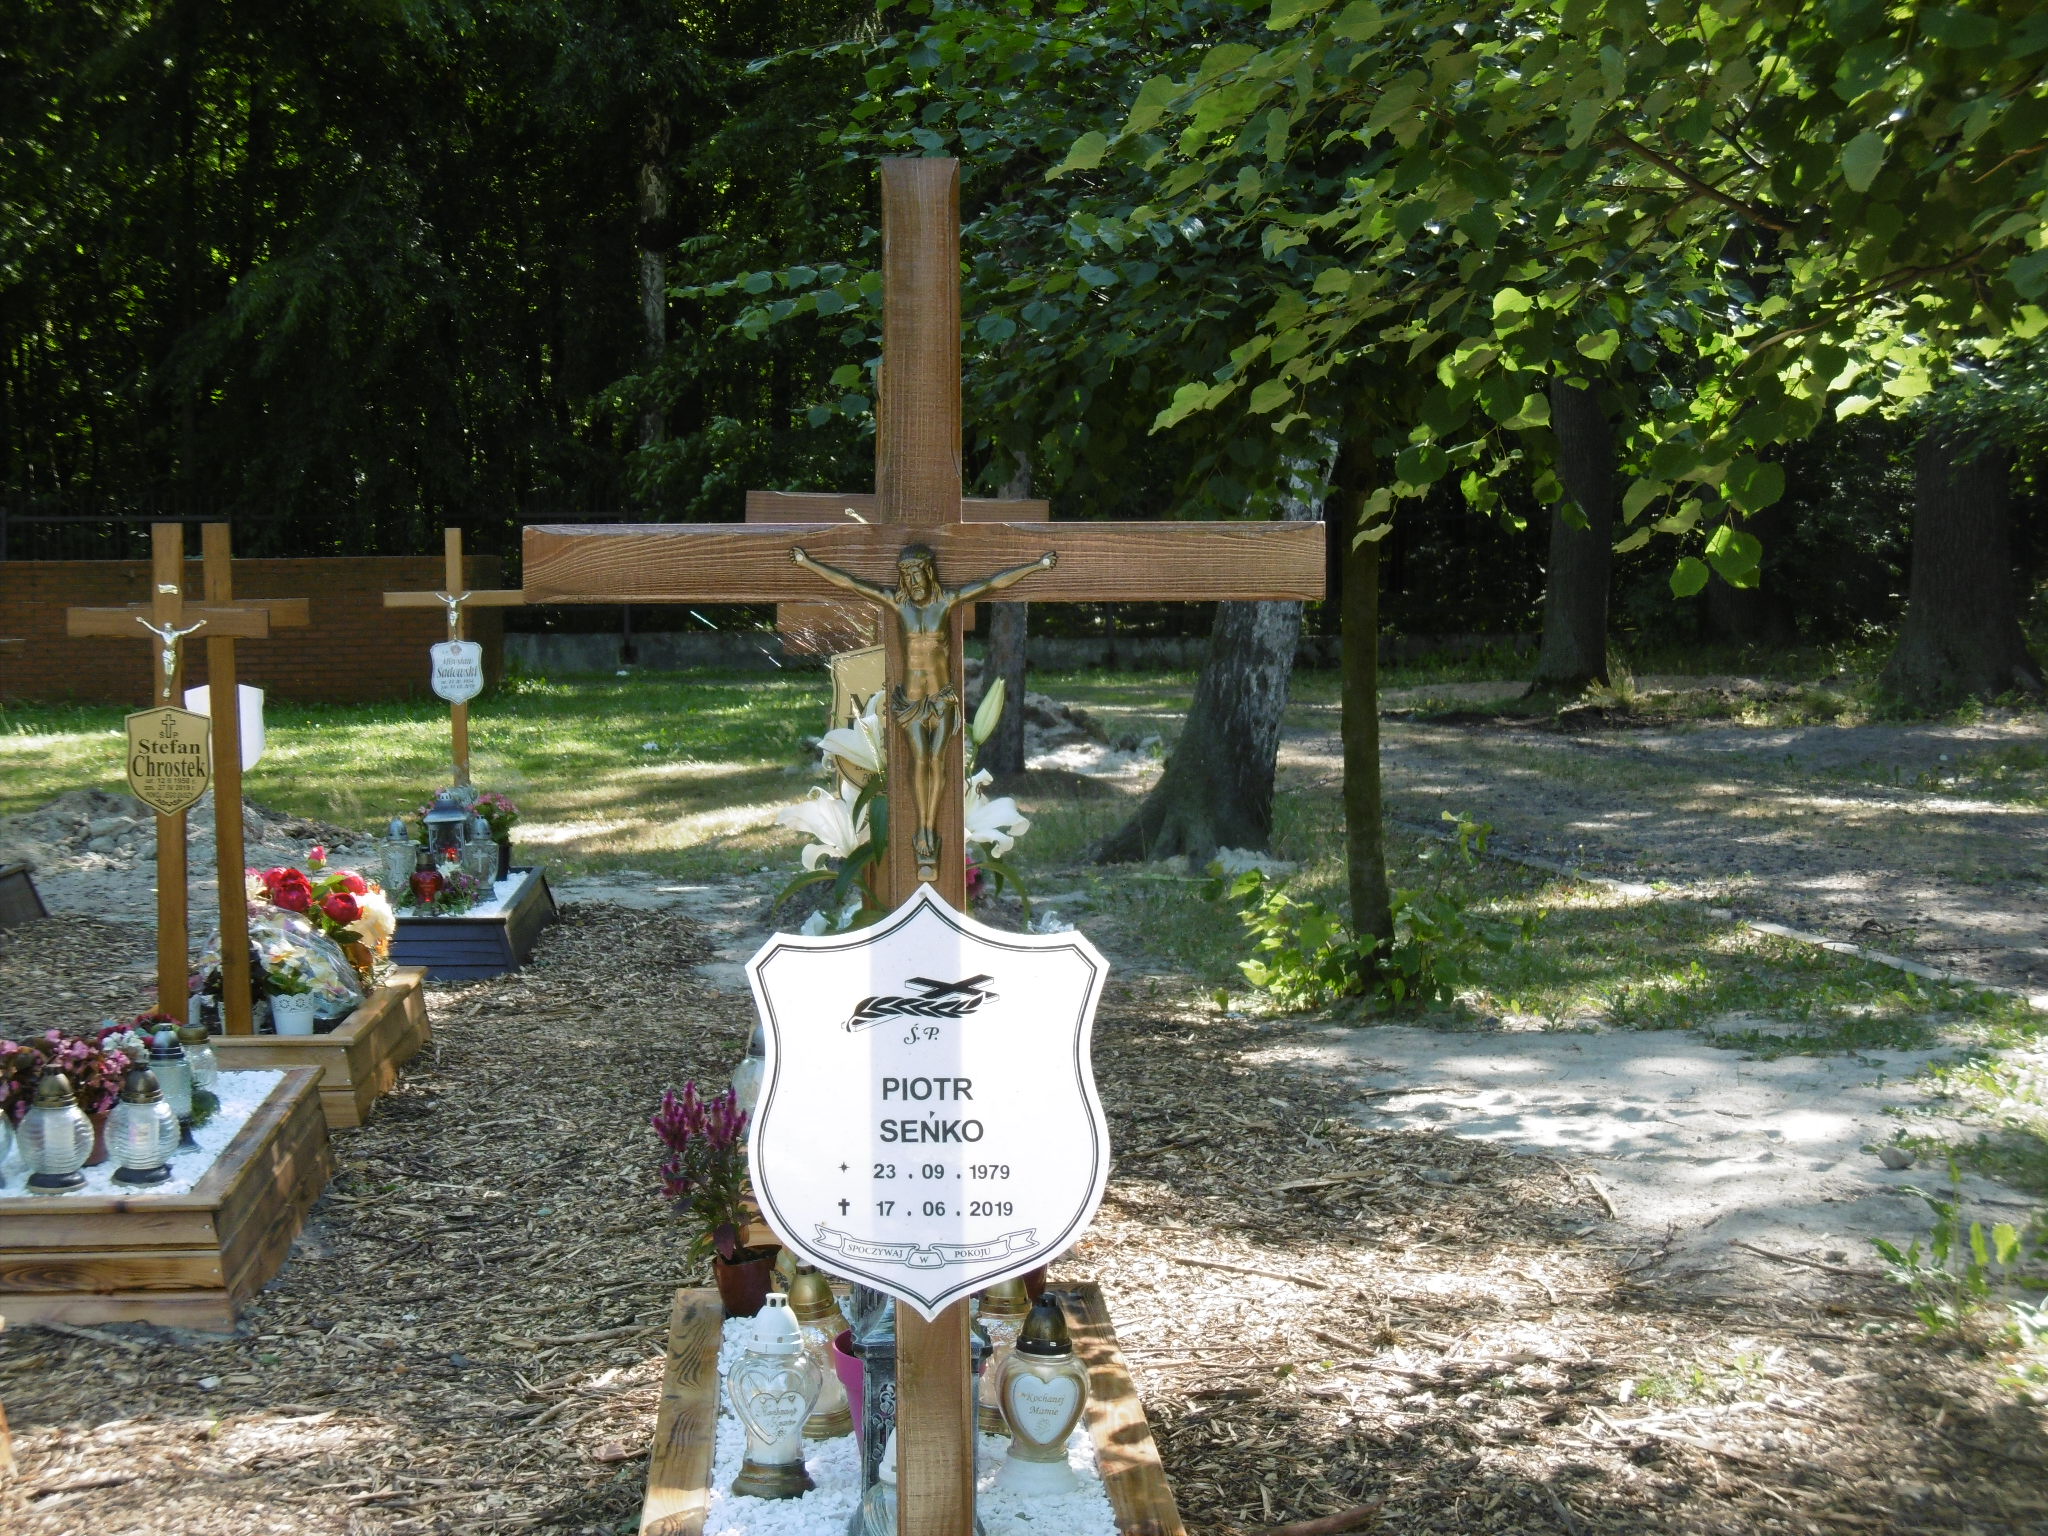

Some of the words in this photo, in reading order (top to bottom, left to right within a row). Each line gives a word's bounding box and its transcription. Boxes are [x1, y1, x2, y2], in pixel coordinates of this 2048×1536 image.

[138, 739, 200, 754] Stefan
[132, 755, 206, 777] Chrostek
[882, 1077, 974, 1101] PIOTR
[880, 1110, 984, 1143] SEŃKO
[847, 1243, 903, 1258] SPOCZYWAJ
[954, 1247, 991, 1258] POKOJU
